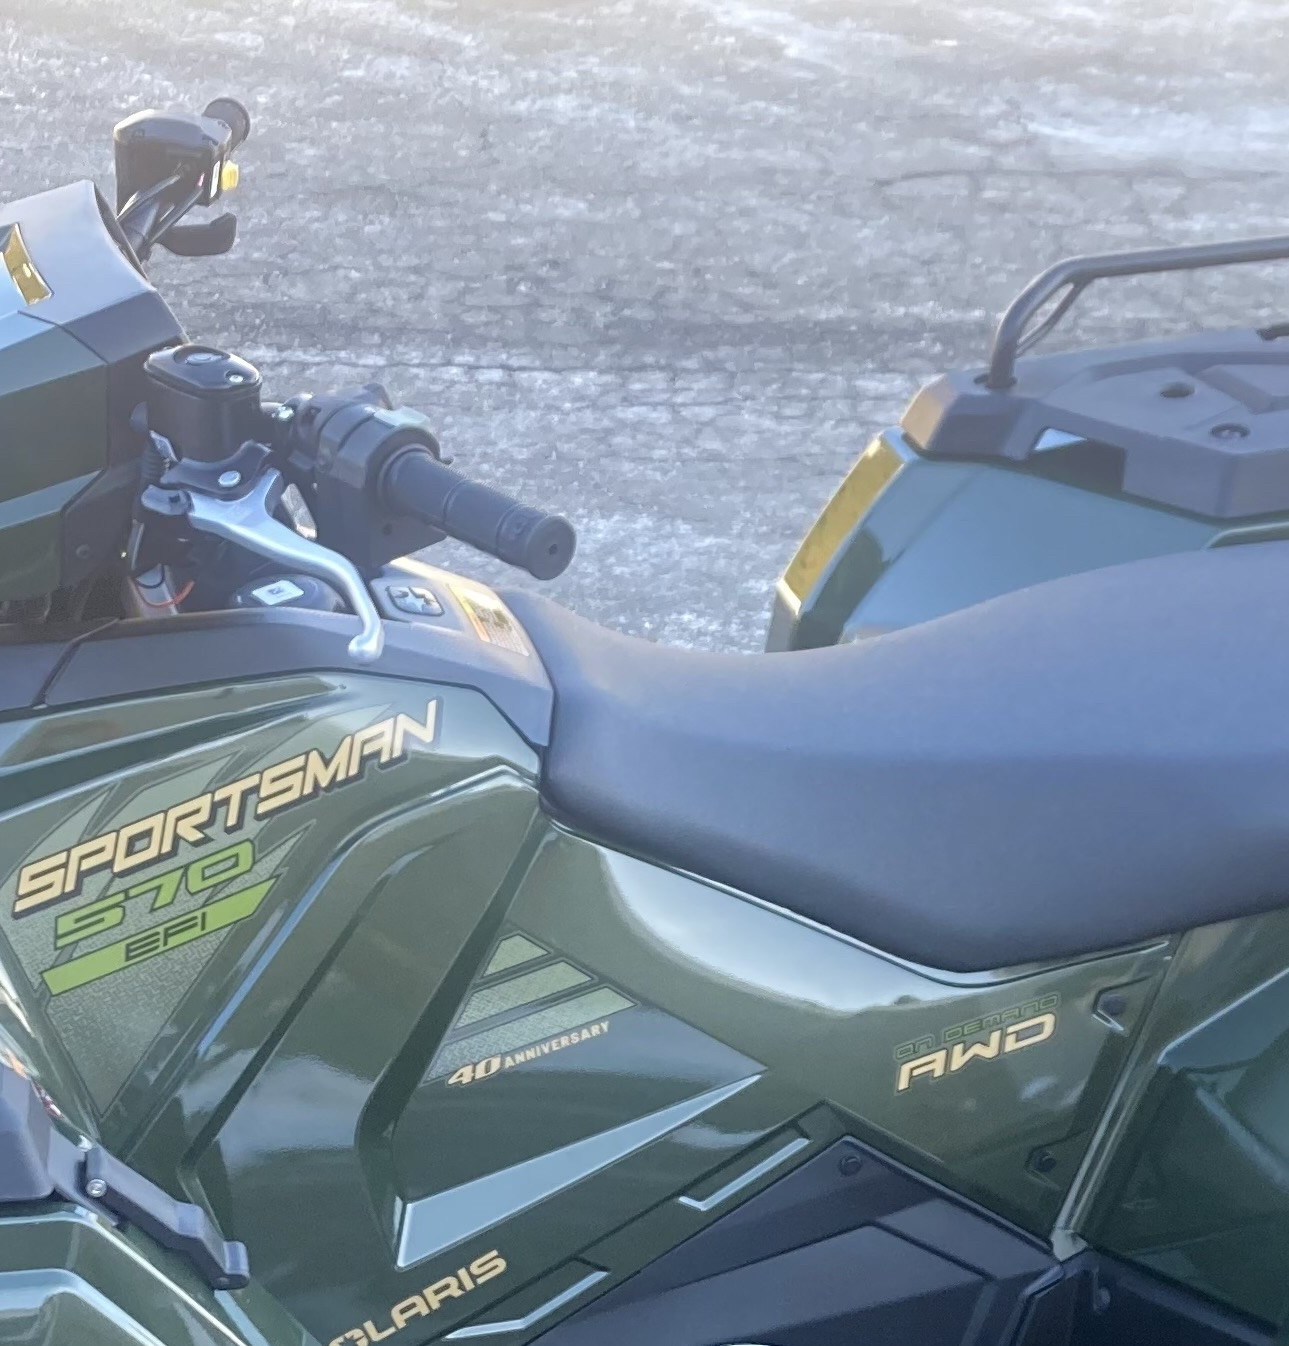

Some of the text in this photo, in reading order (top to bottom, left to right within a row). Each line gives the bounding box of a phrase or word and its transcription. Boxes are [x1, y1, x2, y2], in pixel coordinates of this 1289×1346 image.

[13, 699, 440, 919] SPORTSMAN
[54, 838, 256, 951] 570
[125, 910, 208, 963] EFI
[446, 1020, 610, 1086] 40 ANNIVERSARY
[896, 1012, 1057, 1093] AWD
